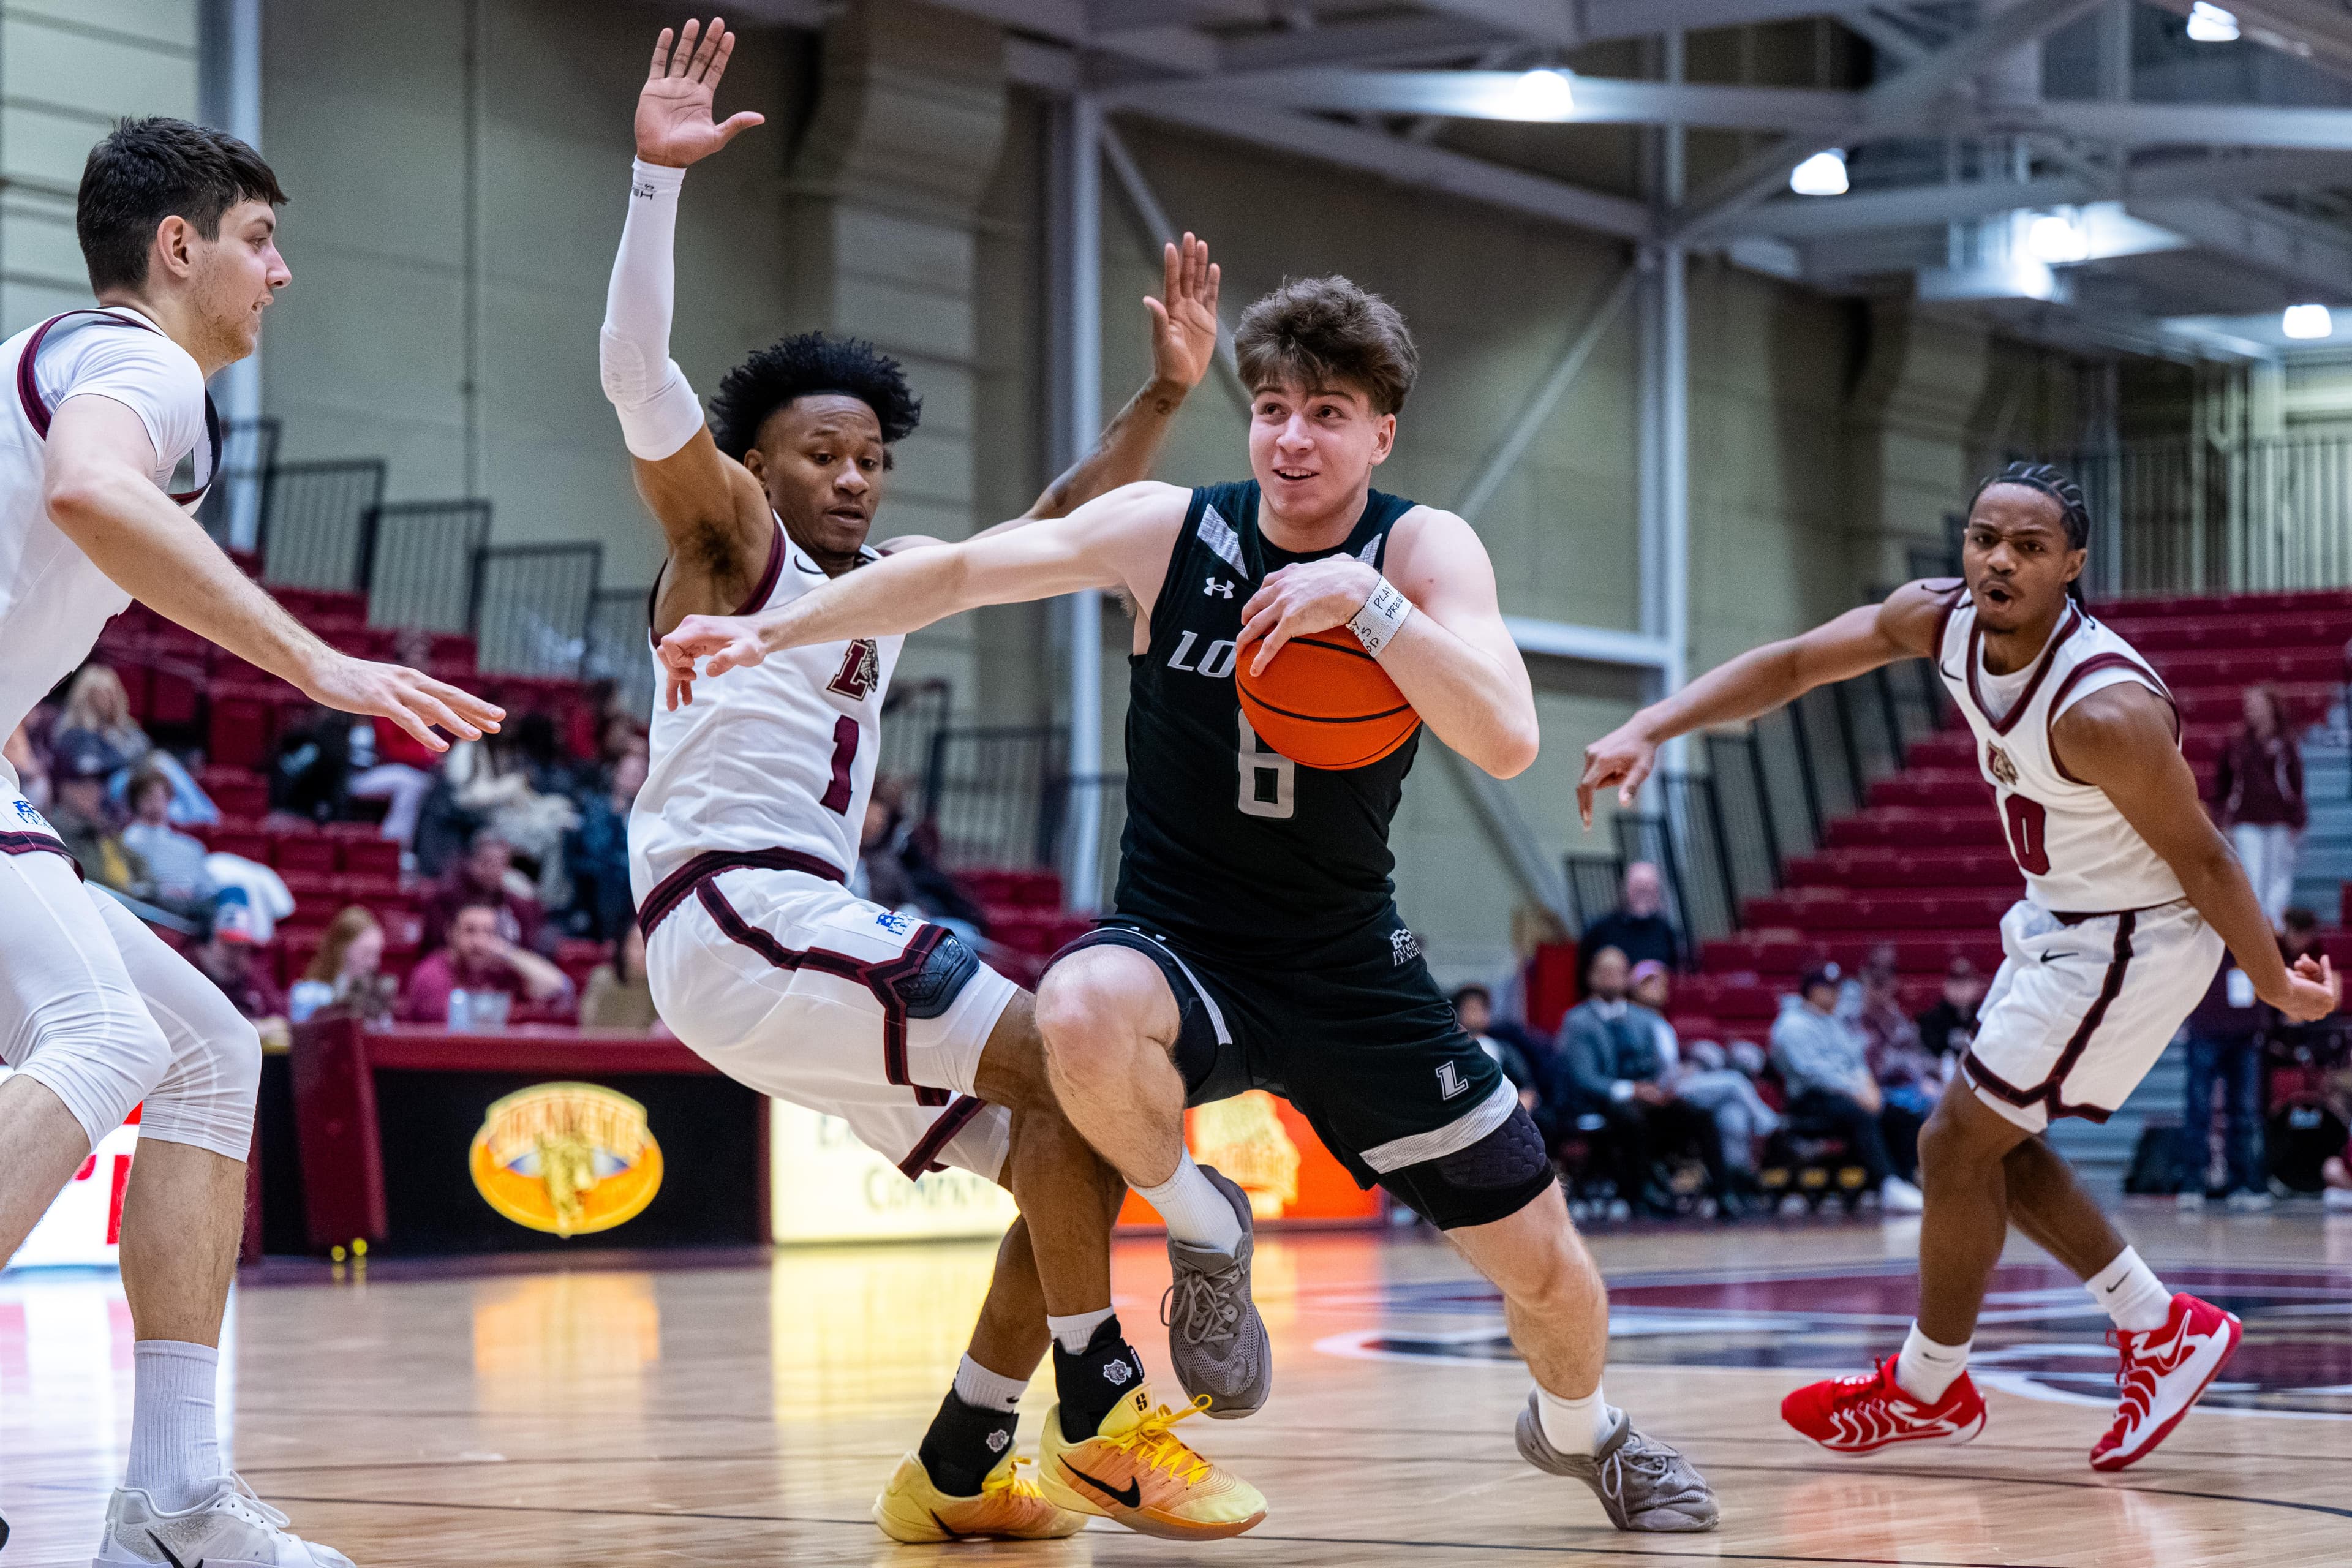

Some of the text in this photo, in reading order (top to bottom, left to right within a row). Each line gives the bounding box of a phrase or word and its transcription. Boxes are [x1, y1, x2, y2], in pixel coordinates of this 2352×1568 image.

[1373, 584, 1394, 610] PLAY
[826, 639, 869, 701] L
[820, 714, 859, 816] 1
[2005, 793, 2051, 876] 0
[1436, 1061, 1469, 1101] L
